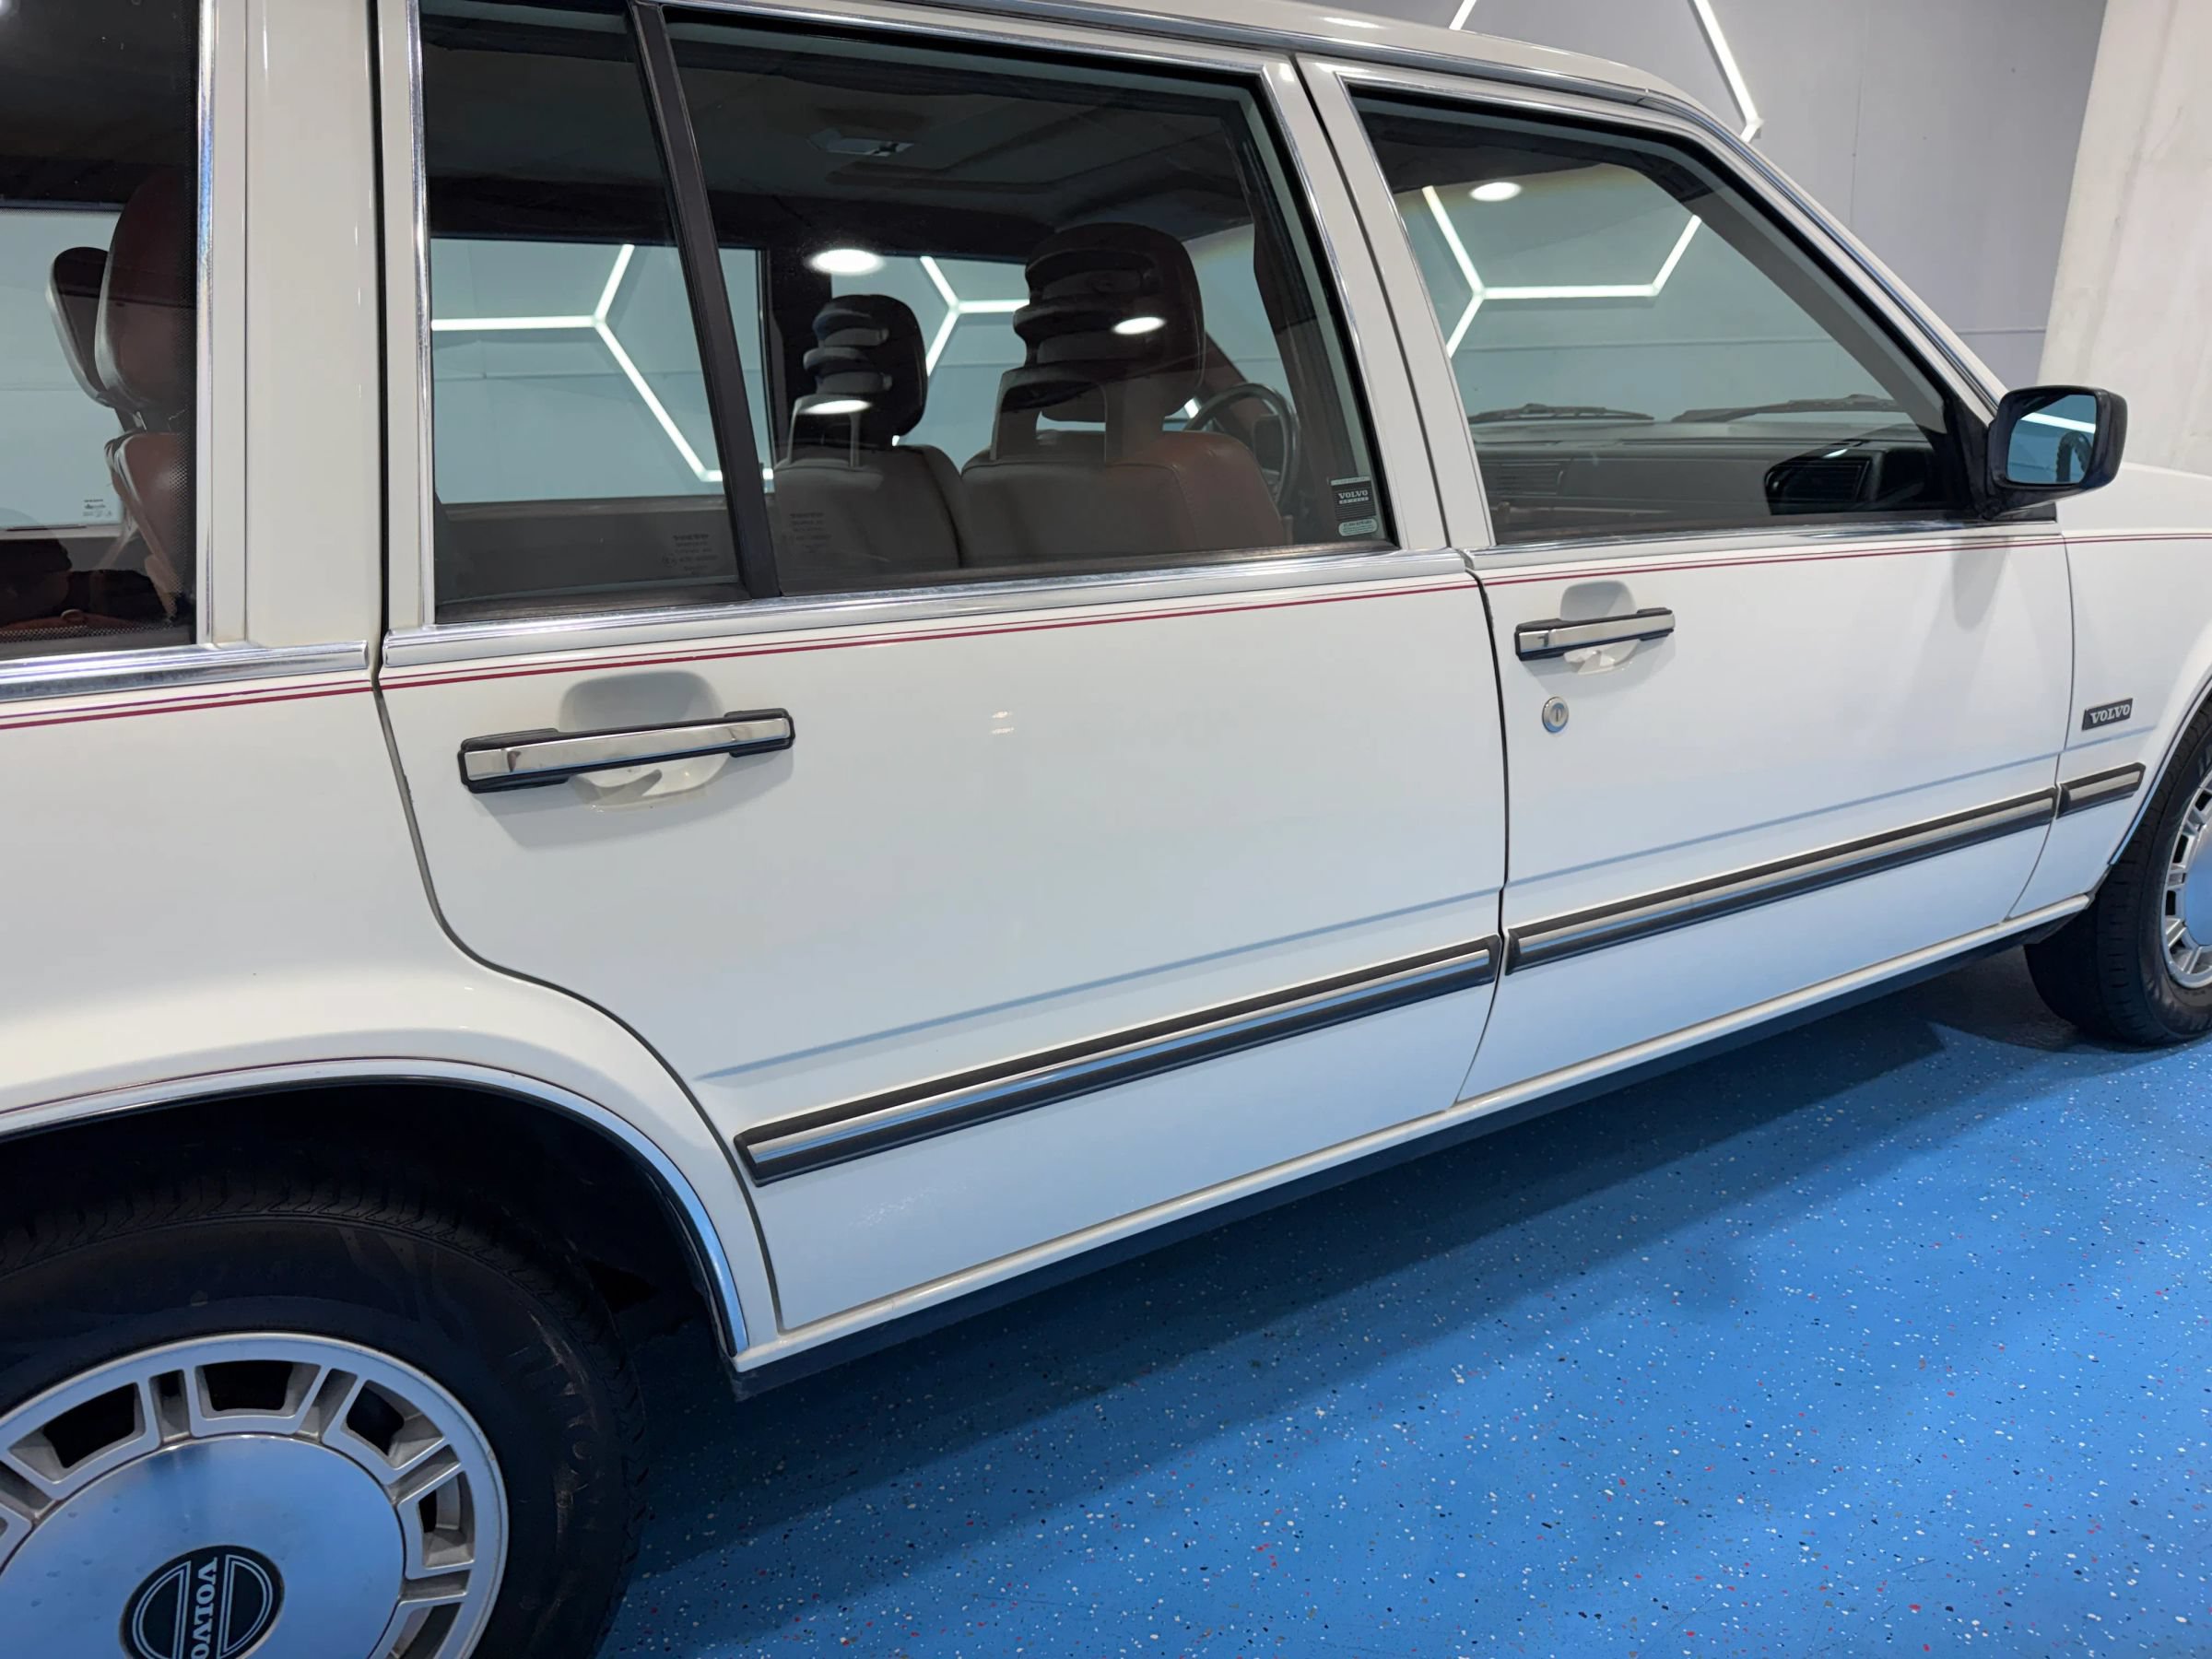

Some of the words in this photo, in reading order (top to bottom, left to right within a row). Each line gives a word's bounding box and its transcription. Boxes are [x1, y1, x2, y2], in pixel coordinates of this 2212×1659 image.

[1338, 489, 1369, 500] VOLVO
[2089, 704, 2131, 724] VOLVO
[191, 1556, 218, 1659] VOLVO
